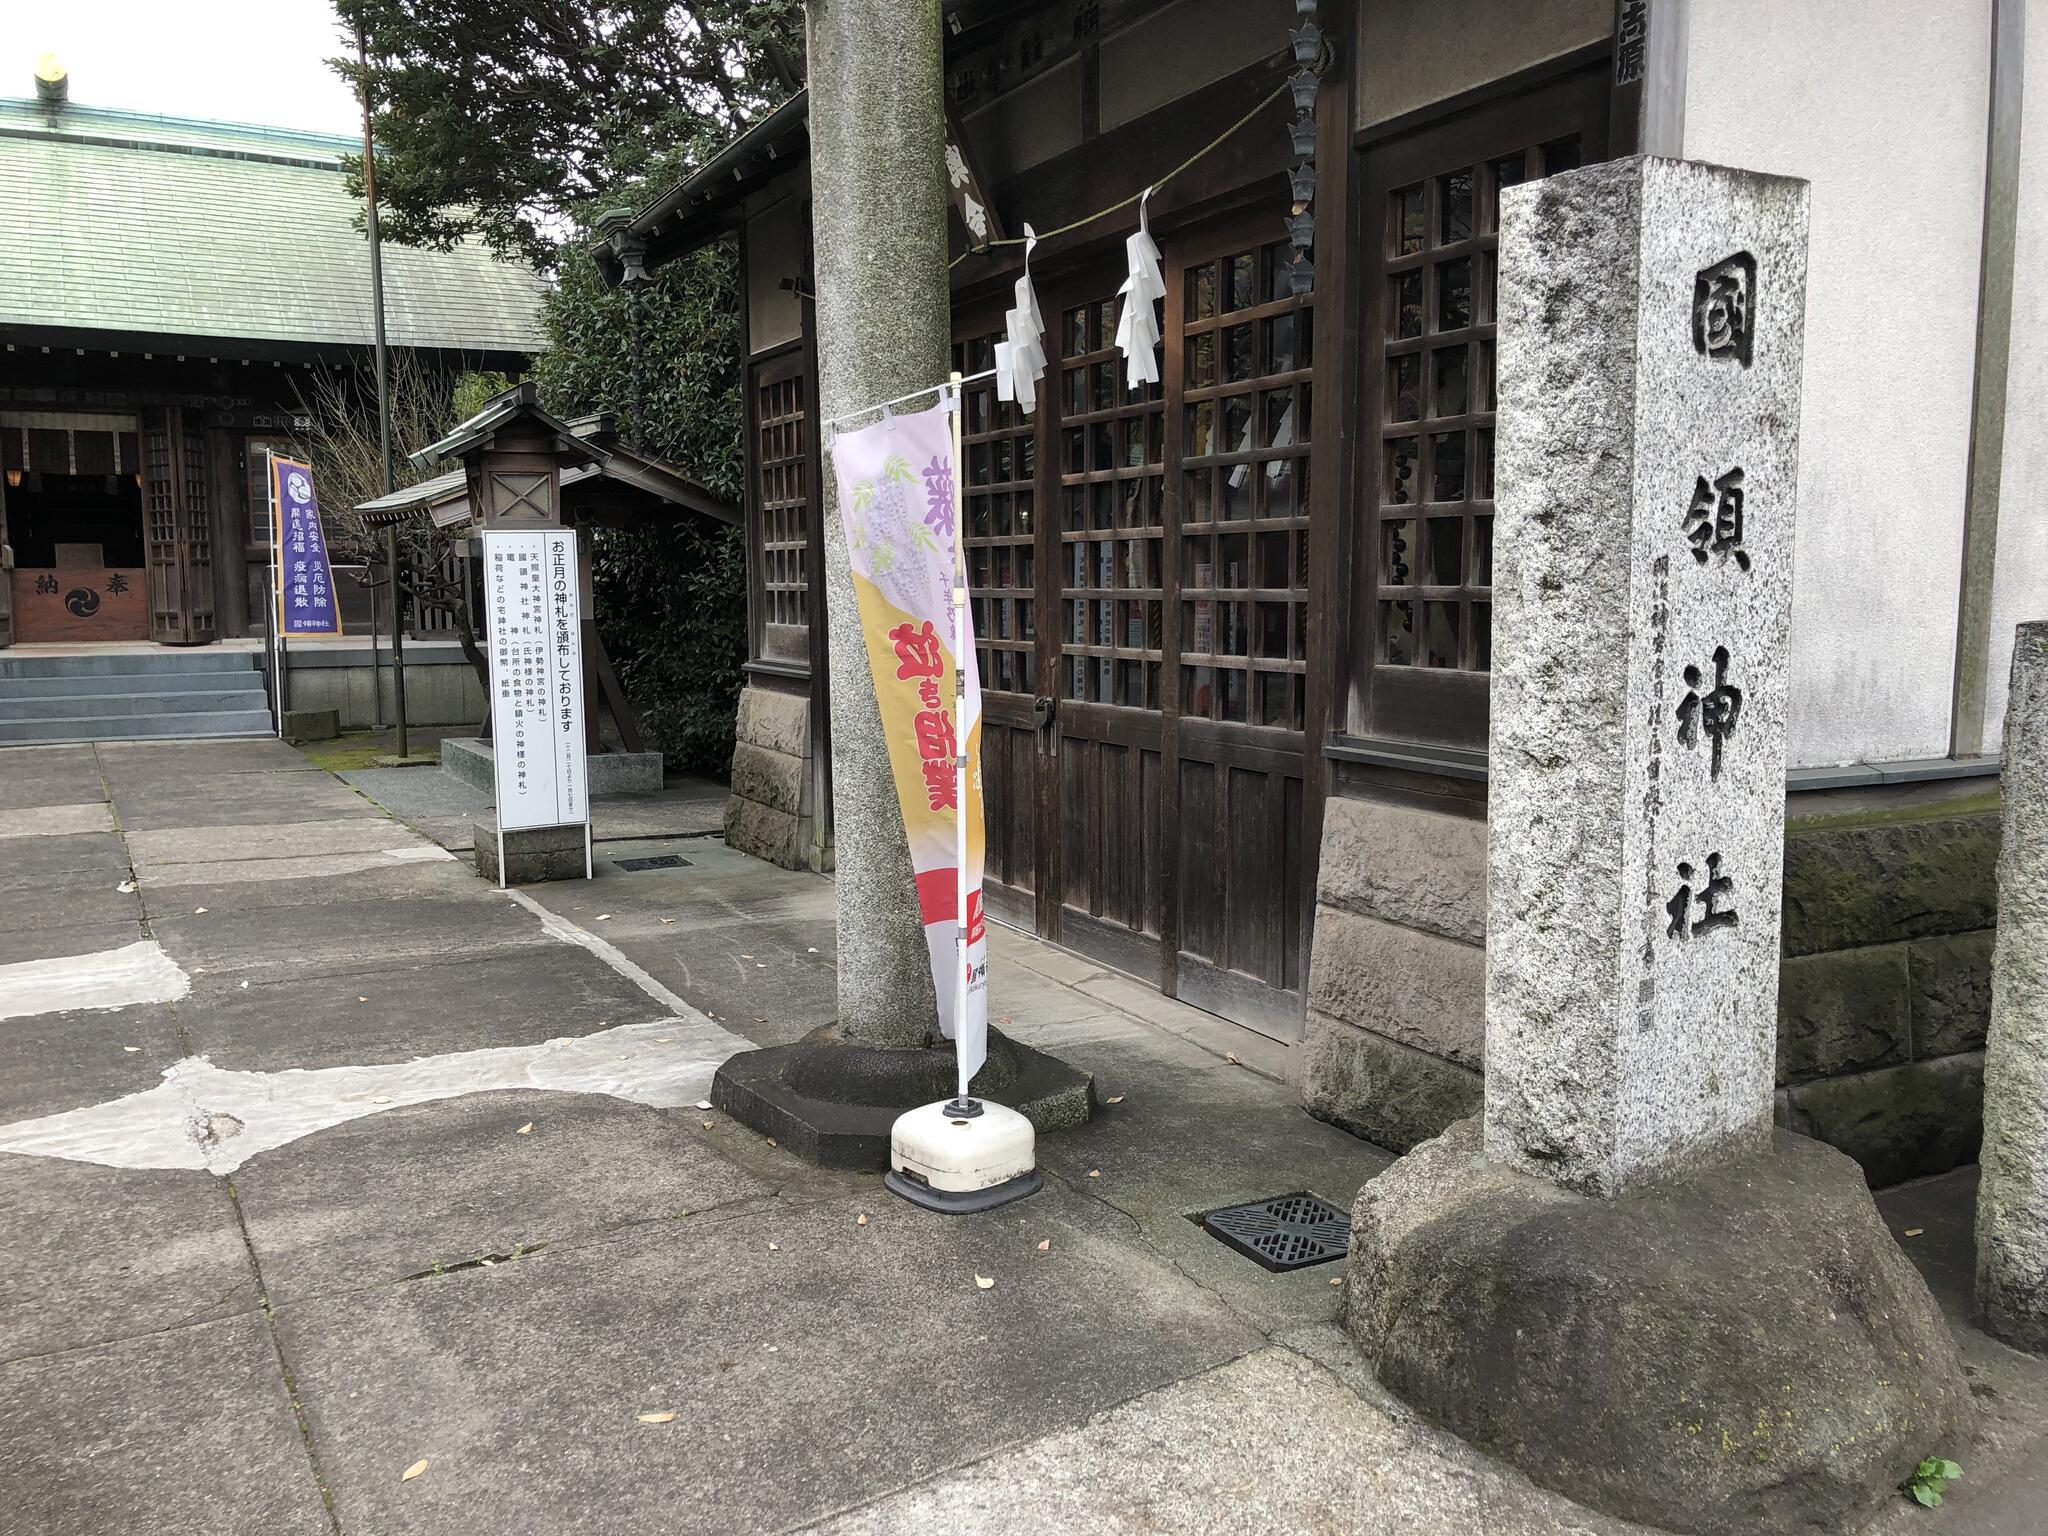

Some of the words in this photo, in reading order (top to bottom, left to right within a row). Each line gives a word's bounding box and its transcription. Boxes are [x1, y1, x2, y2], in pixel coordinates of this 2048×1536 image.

[294, 561, 309, 608] 疫病退散
[305, 509, 320, 553] 家内安全
[313, 561, 328, 607] 災厄防除
[1666, 248, 1757, 940] 國領神社
[551, 541, 574, 733] お正月の神札を頒布しております
